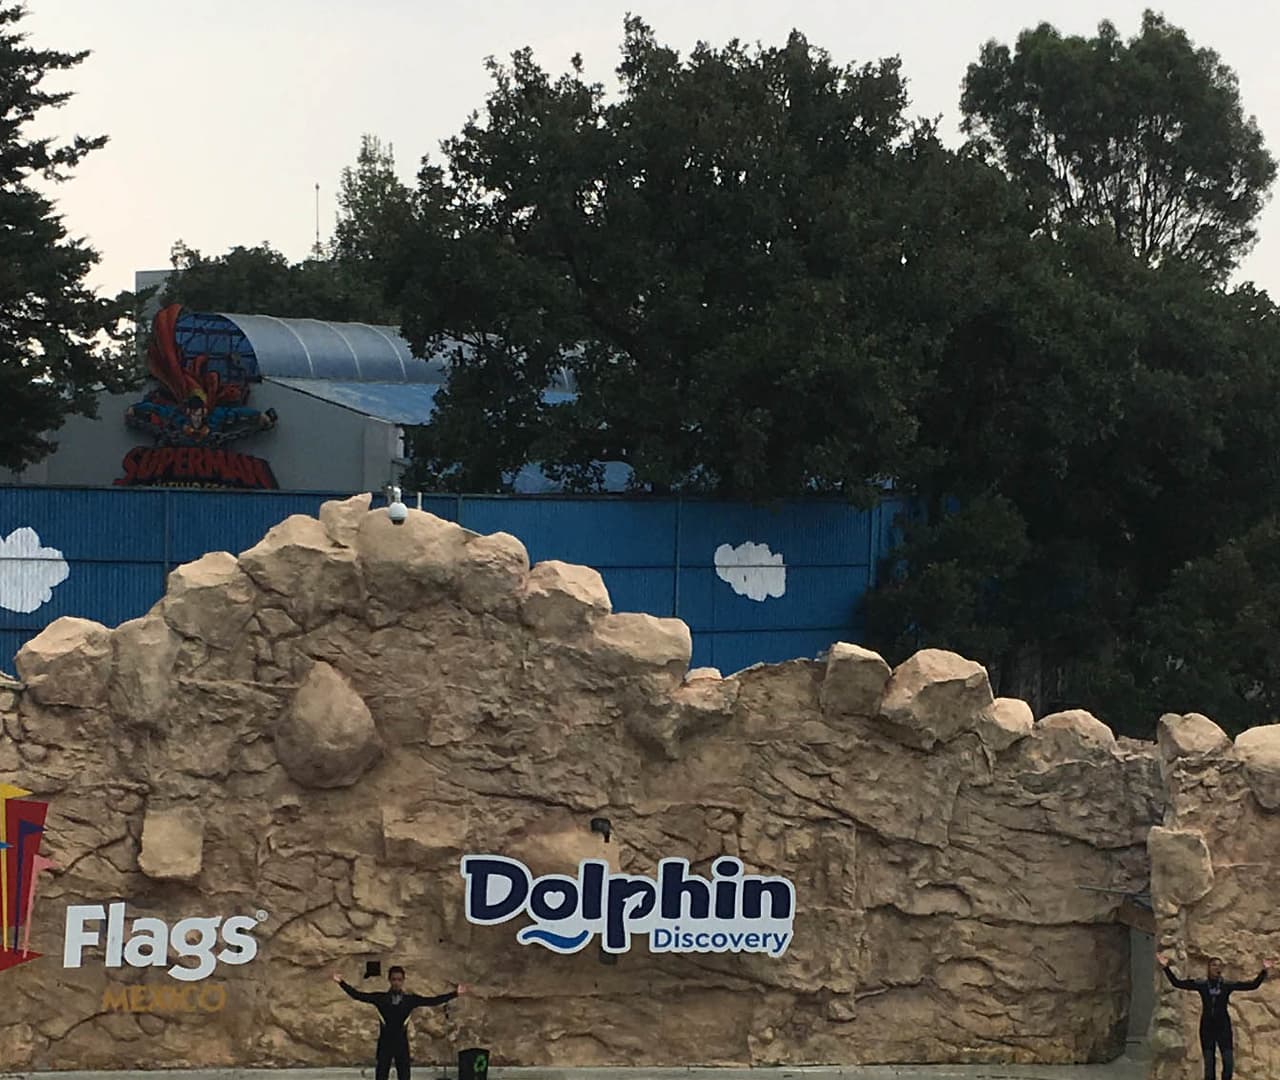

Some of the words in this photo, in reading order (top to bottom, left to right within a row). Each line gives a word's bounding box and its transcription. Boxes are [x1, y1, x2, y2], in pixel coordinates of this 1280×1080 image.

[113, 446, 276, 489] SUPERMAN
[464, 858, 793, 950] Dolphin
[654, 927, 789, 953] Discovery
[102, 984, 226, 1013] MEXICO
